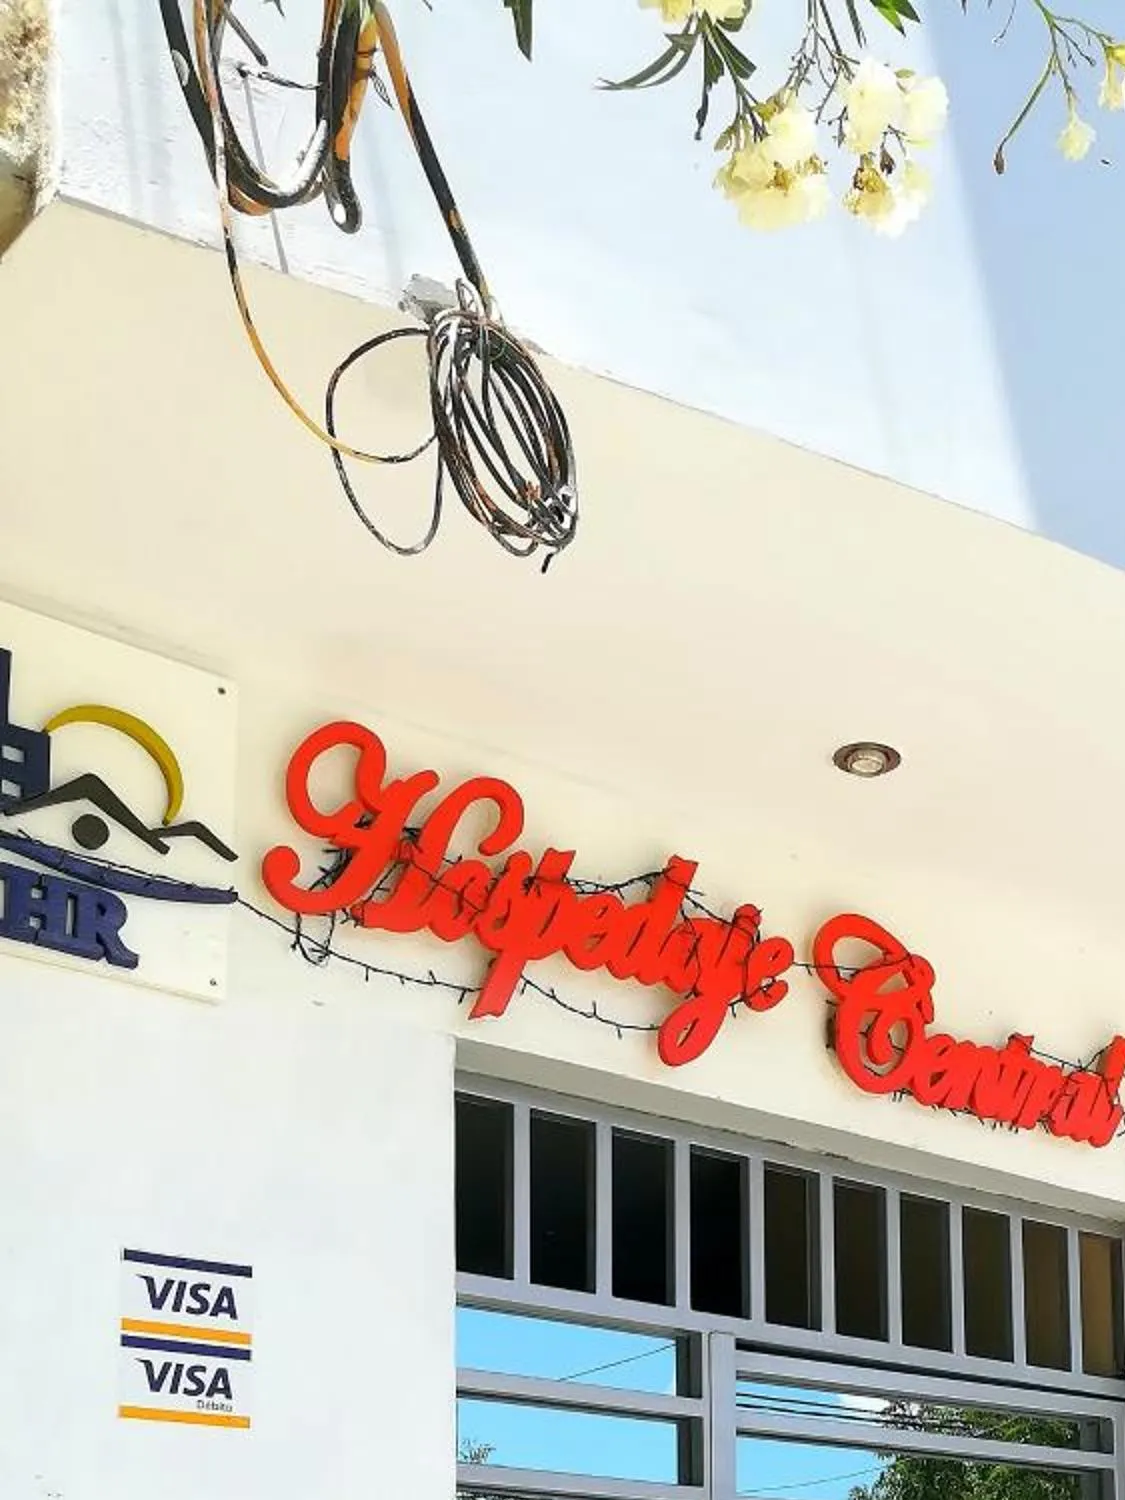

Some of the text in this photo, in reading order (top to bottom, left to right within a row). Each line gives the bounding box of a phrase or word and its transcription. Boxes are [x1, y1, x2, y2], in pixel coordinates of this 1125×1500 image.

[262, 721, 794, 1066] Hospedaje
[136, 1274, 238, 1320] VISA
[135, 1357, 233, 1400] VISA
